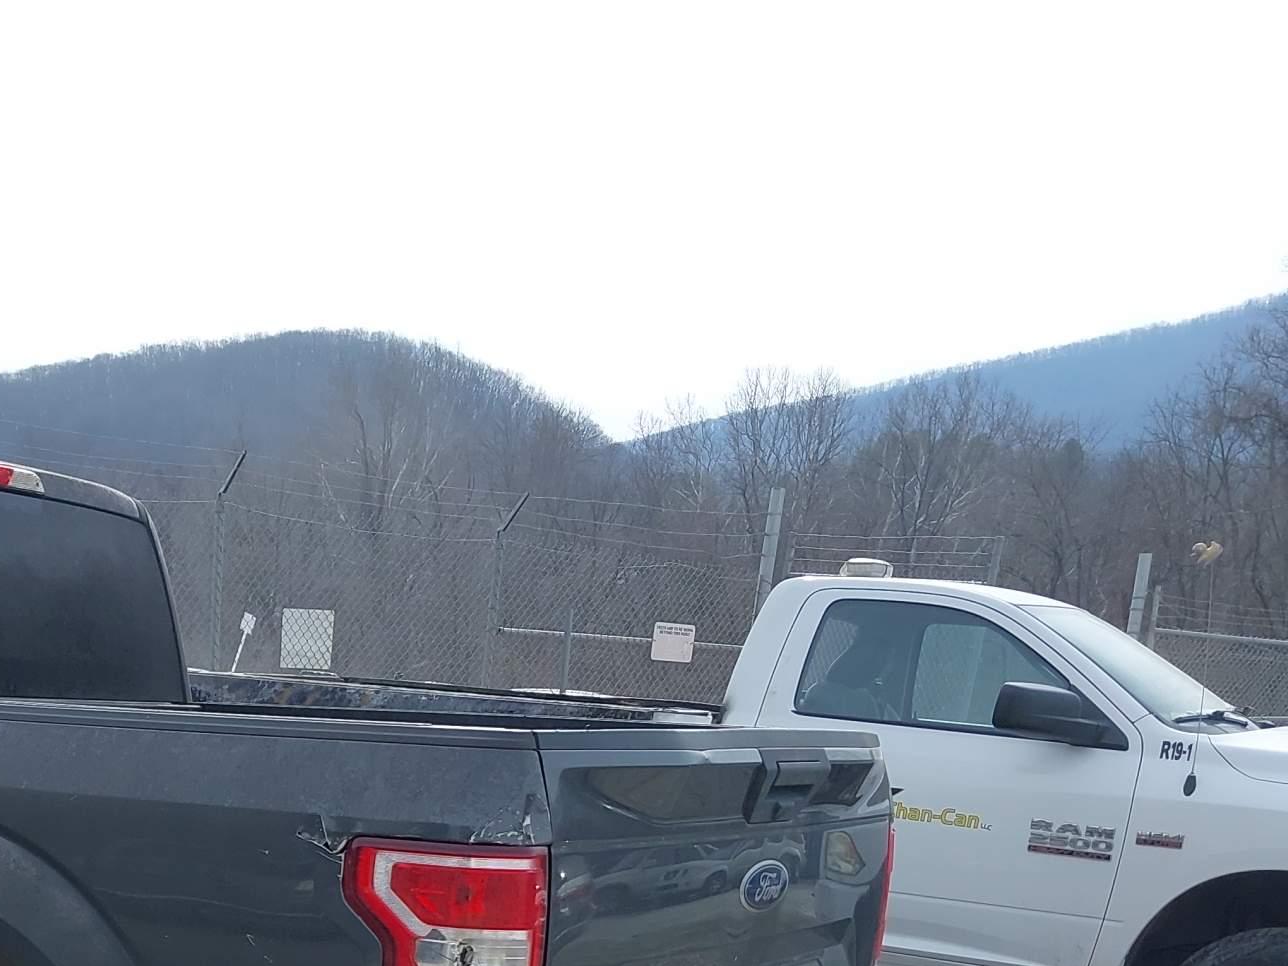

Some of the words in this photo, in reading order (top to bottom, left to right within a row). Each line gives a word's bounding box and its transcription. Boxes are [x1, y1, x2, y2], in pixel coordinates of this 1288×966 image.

[1159, 740, 1193, 762] R19-1
[1031, 818, 1116, 840] RAM
[1028, 831, 1114, 852] 2500
